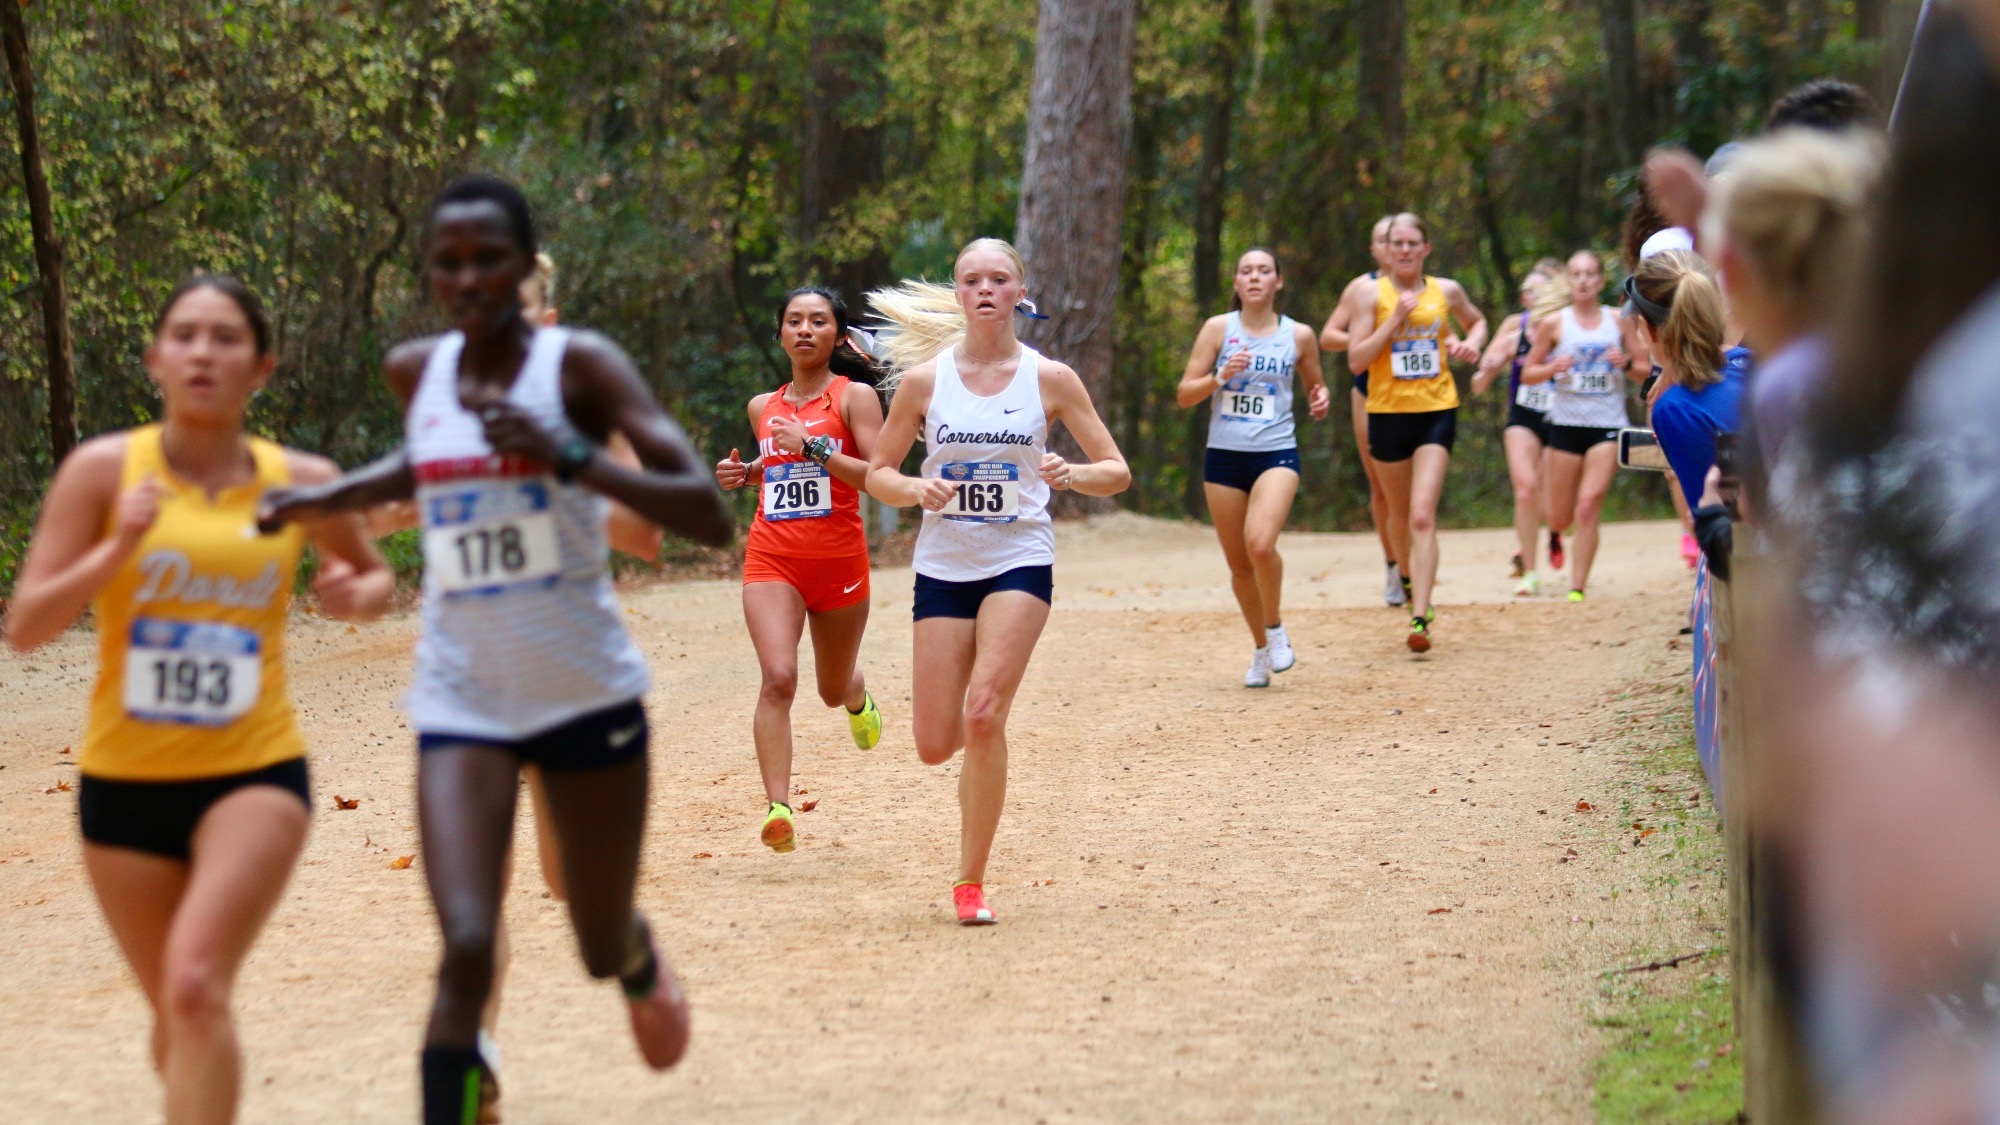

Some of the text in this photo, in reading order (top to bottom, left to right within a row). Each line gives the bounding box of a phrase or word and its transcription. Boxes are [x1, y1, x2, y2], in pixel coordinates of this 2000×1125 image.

[1401, 354, 1432, 371] 186
[1231, 395, 1264, 415] 156
[936, 424, 1034, 446] Cornerstone
[773, 480, 819, 510] 296
[956, 483, 1003, 512] 163
[456, 525, 526, 577] 178
[153, 659, 232, 707] 193
